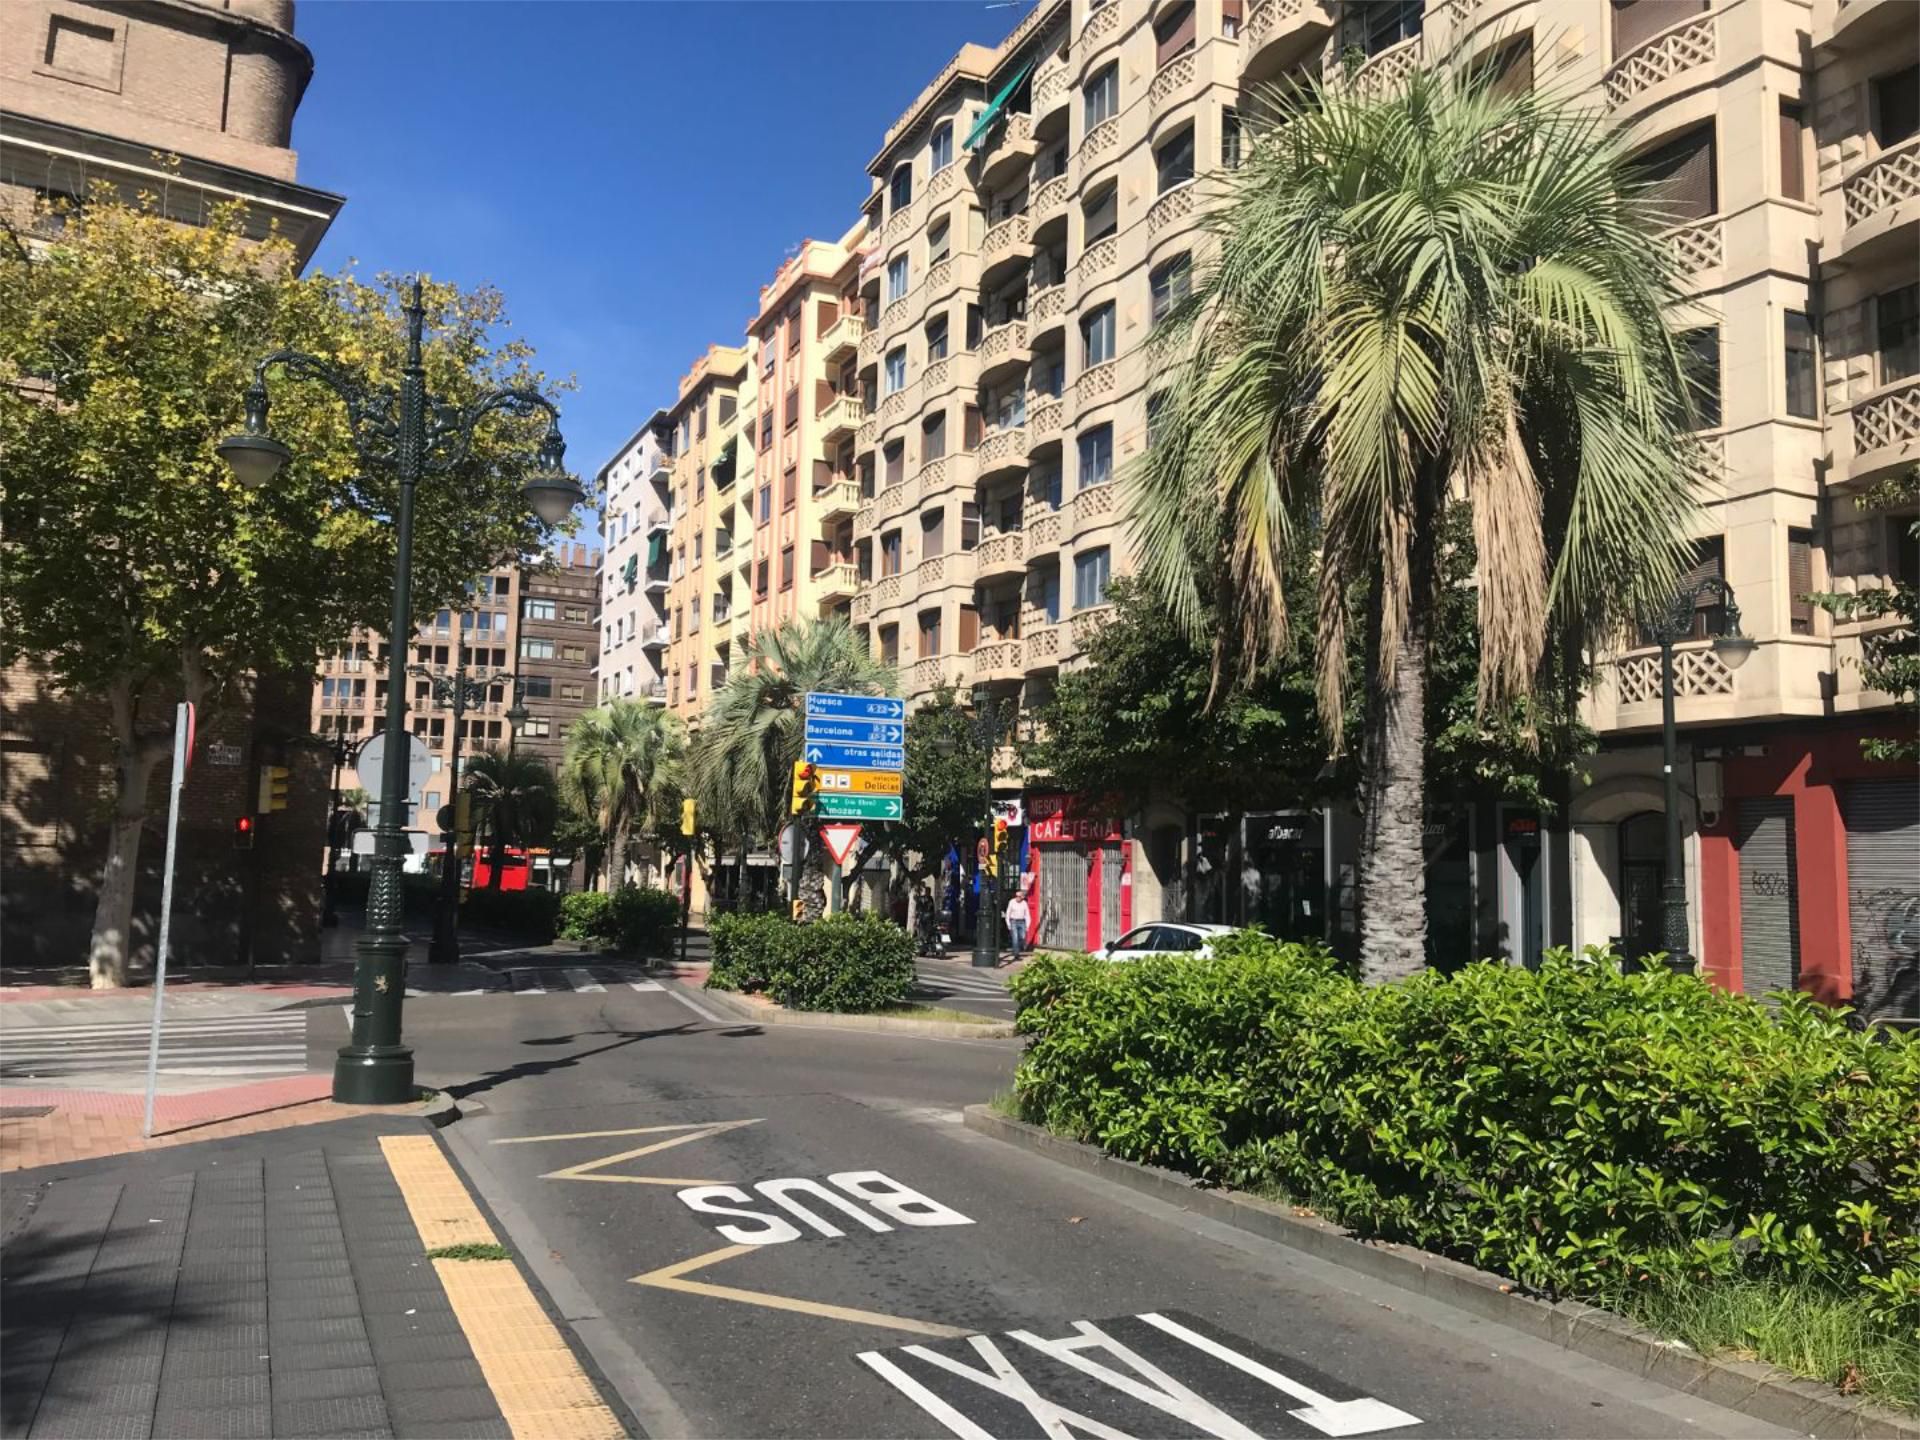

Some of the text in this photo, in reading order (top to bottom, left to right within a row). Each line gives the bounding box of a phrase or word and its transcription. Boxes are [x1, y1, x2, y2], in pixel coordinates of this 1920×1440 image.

[808, 695, 843, 706] Huesca
[808, 704, 826, 713] Pau
[808, 725, 853, 736] Barcelona
[843, 748, 901, 758] otras salidas
[871, 759, 902, 767] ciudad
[864, 781, 900, 791] Delicias
[676, 1170, 977, 1245] BUS
[856, 1312, 1424, 1440] TAXI
